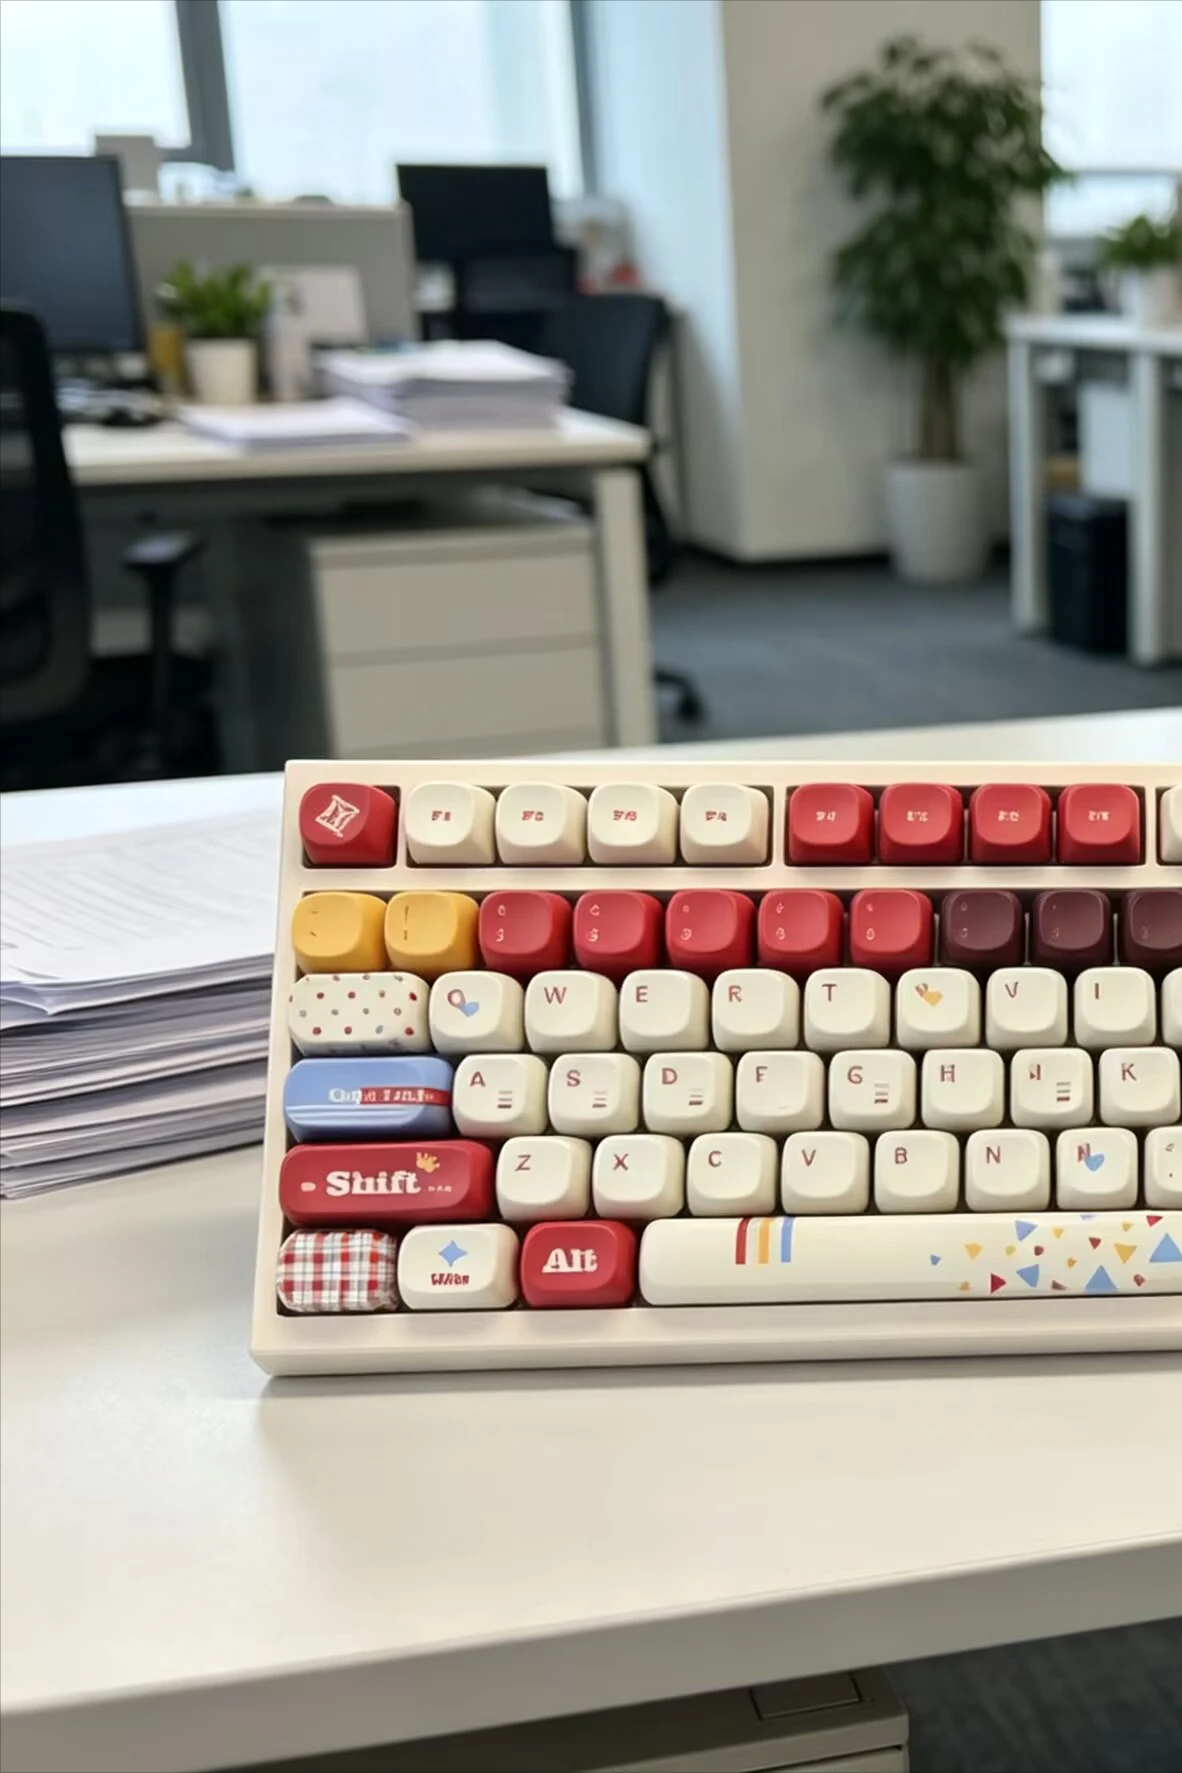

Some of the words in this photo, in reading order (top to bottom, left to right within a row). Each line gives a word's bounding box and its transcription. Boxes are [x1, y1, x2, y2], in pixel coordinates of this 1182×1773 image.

[544, 986, 567, 1004] W
[636, 985, 649, 1003] E
[728, 984, 742, 1002] R
[821, 983, 838, 1002] T
[470, 1071, 486, 1088] A
[566, 1069, 582, 1087] S
[661, 1067, 678, 1085] D
[847, 1065, 864, 1084] G
[940, 1064, 956, 1083] H
[1121, 1062, 1138, 1081] K
[514, 1154, 532, 1172] Z
[612, 1153, 629, 1171] X
[707, 1150, 723, 1168] C
[801, 1149, 817, 1167] V
[893, 1147, 909, 1165] B
[986, 1146, 1001, 1164] N
[326, 1170, 421, 1196] Shift
[542, 1247, 598, 1273] Alt
